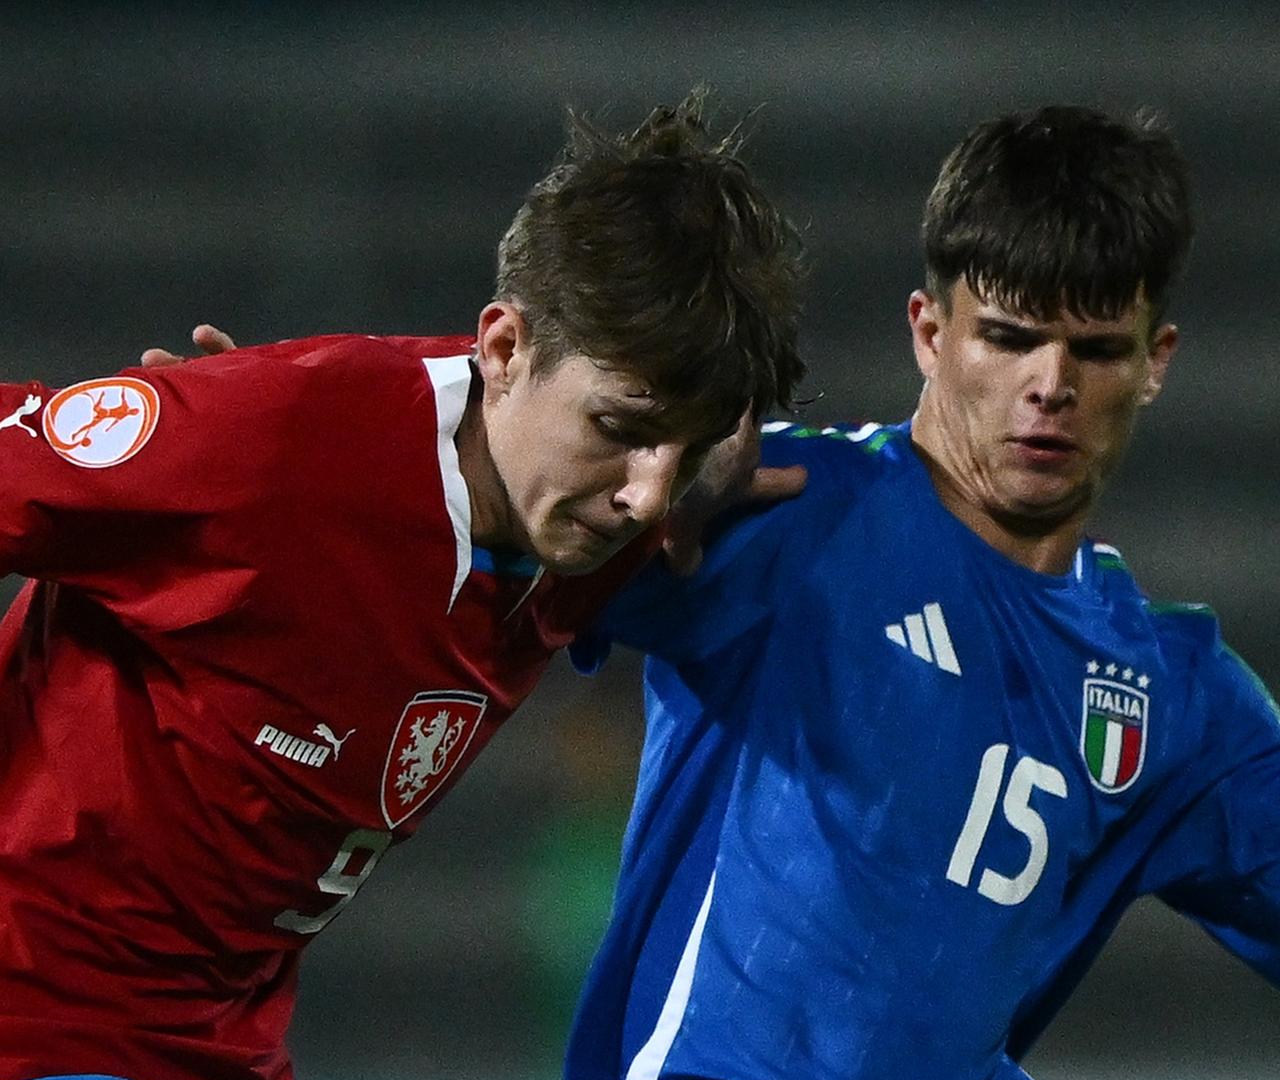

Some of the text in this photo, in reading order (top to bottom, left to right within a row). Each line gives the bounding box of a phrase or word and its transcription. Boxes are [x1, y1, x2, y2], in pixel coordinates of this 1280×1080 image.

[1088, 687, 1142, 718] ITALIA
[254, 724, 331, 768] PUMA
[946, 743, 1068, 906] 15
[273, 829, 393, 934] 9
